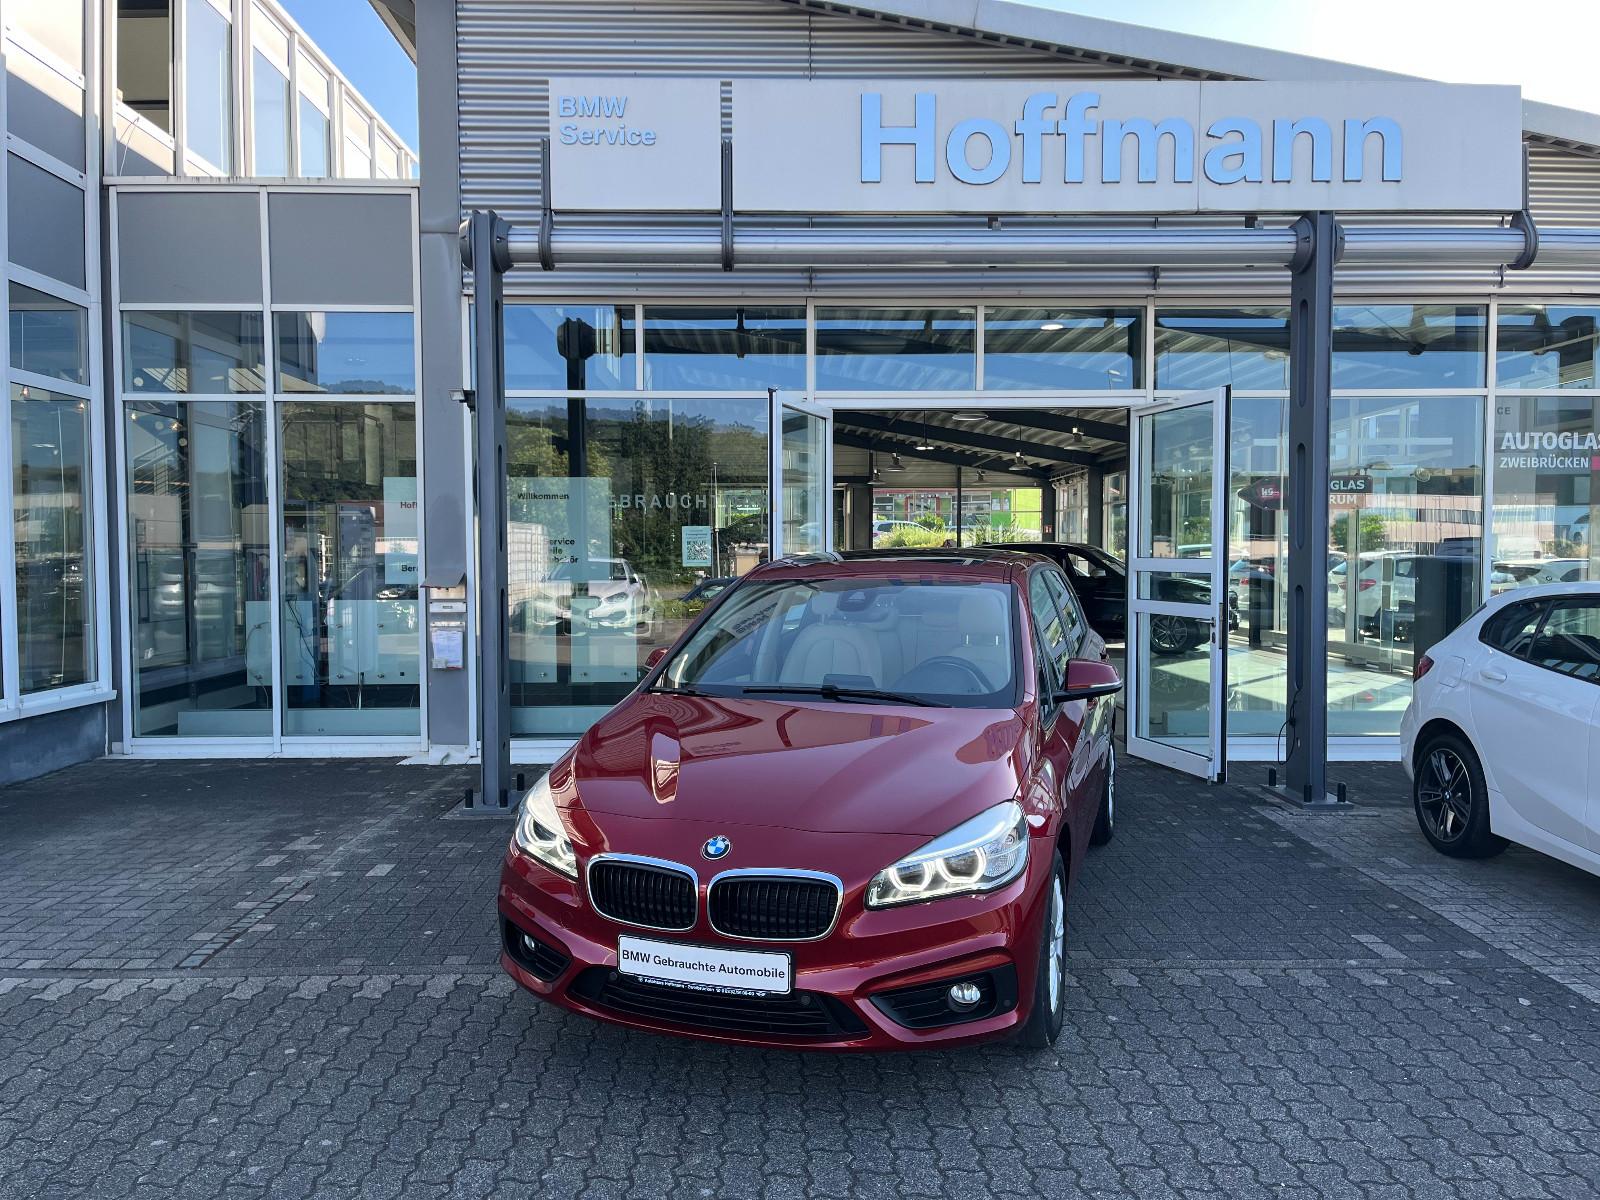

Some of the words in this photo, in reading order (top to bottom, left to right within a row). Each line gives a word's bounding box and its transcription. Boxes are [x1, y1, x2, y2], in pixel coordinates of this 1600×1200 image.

[558, 95, 628, 118] BMW
[559, 123, 657, 146] Service
[860, 93, 1404, 185] Hoffmann
[1500, 431, 1600, 450] AUTOGLA
[1499, 453, 1589, 469] ZWEIBRÜCKEN
[548, 537, 576, 546] ervice
[622, 950, 650, 963] BMW
[653, 955, 716, 972] Gebrauchte
[718, 963, 786, 978] Automobile
